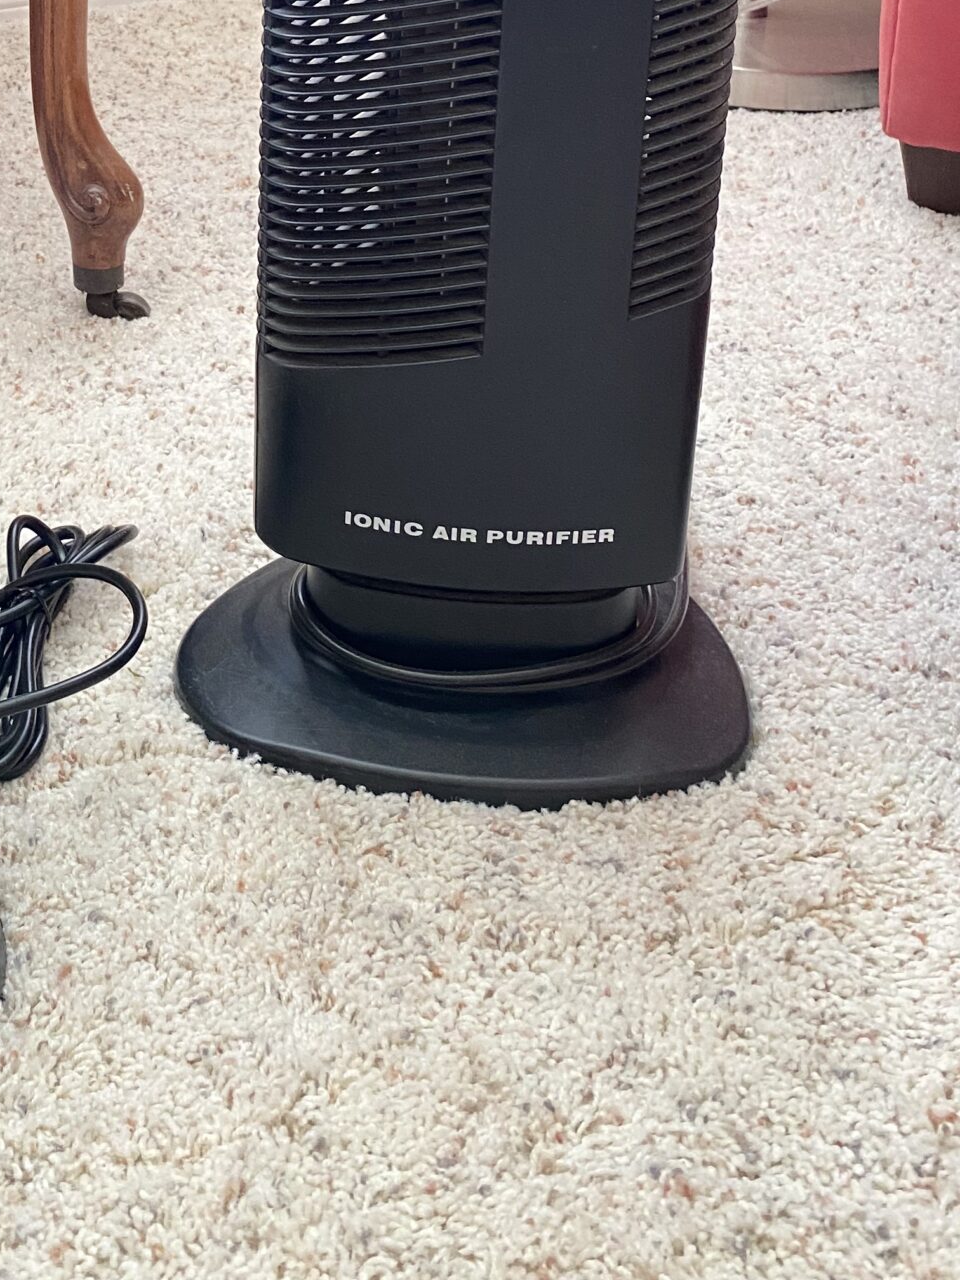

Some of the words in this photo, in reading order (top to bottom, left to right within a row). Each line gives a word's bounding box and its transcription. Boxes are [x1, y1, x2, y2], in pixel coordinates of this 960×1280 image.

[344, 510, 424, 537] IONIC
[432, 525, 478, 543] AIR
[486, 528, 615, 546] PURIFIER
